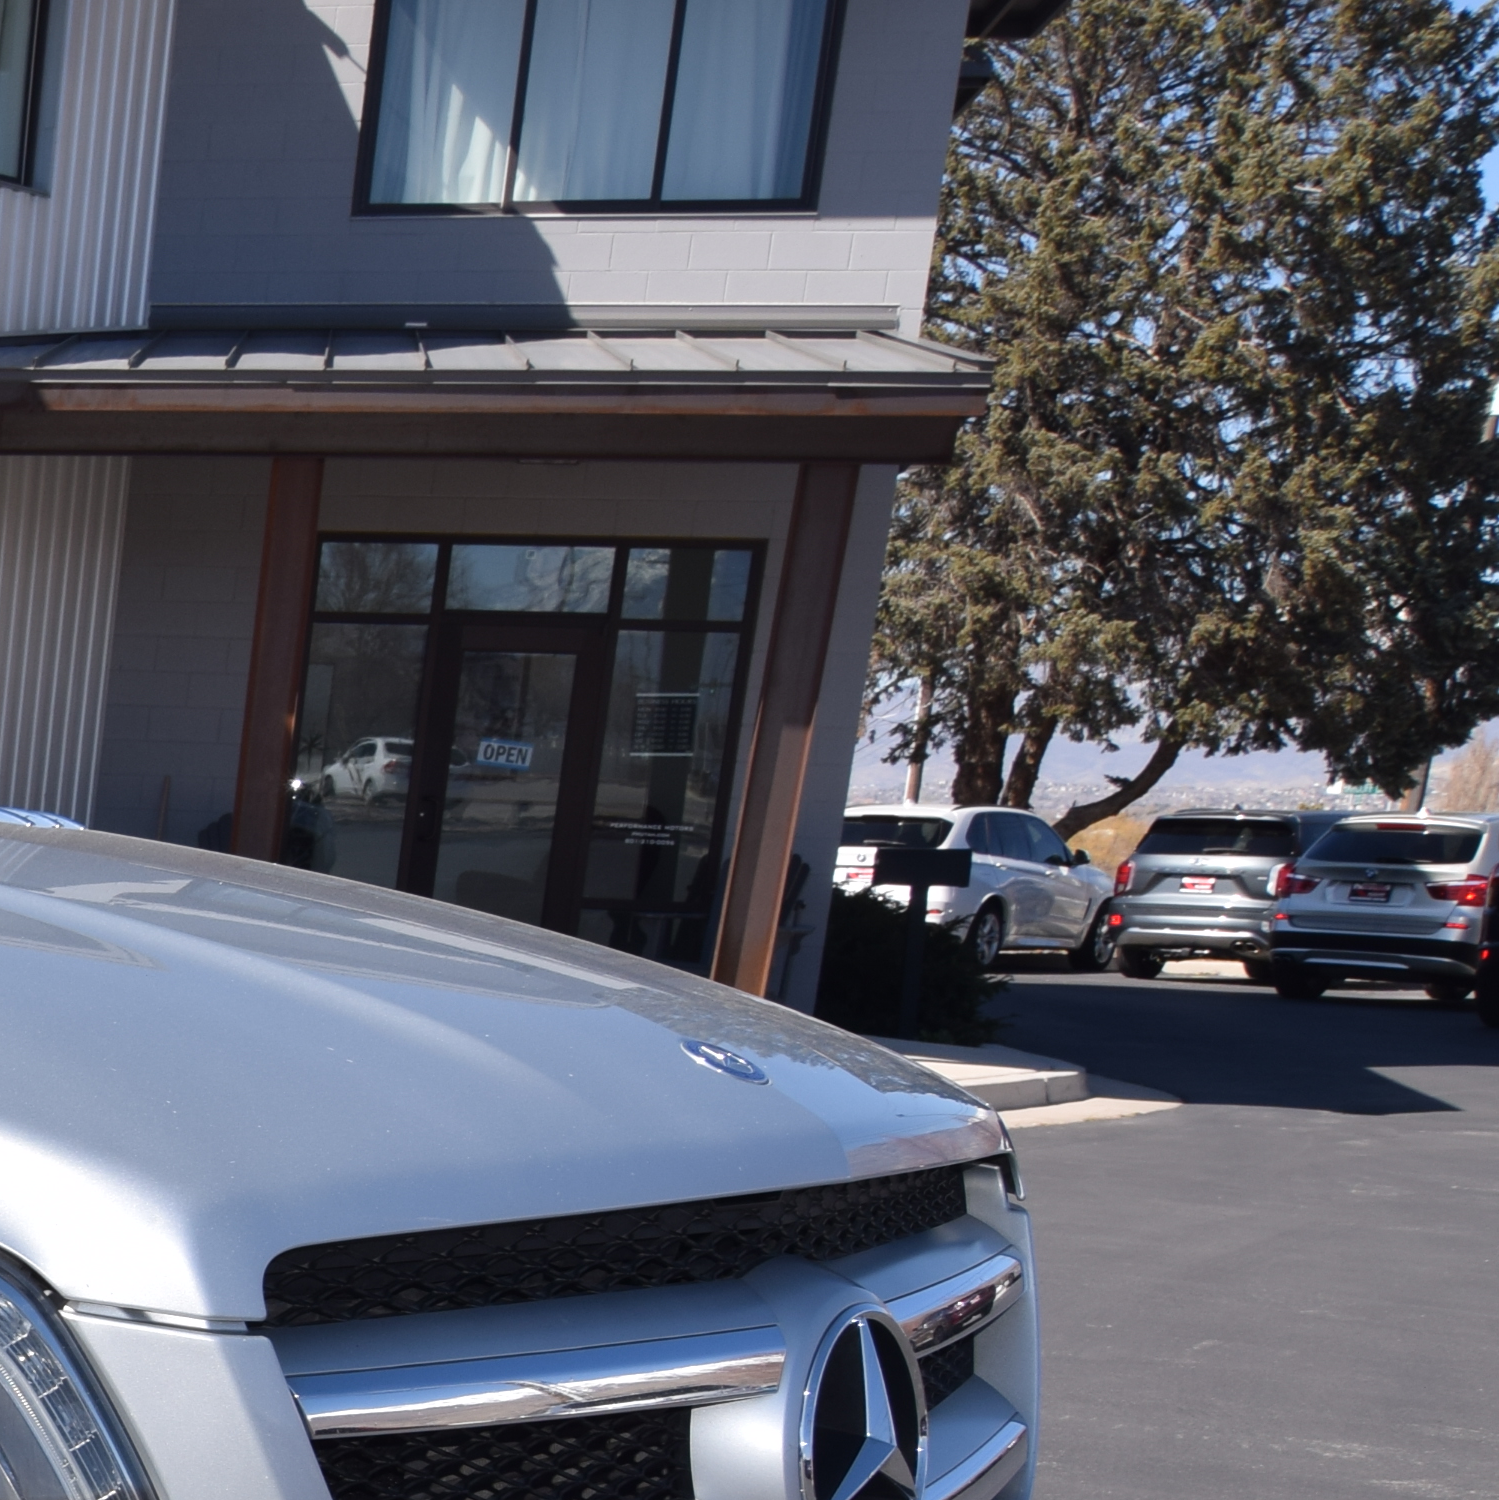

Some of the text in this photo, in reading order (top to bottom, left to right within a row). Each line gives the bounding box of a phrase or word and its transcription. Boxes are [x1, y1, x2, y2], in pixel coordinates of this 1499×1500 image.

[483, 743, 529, 765] OPEN
[609, 822, 695, 833] PERFORMANCE MOTORS
